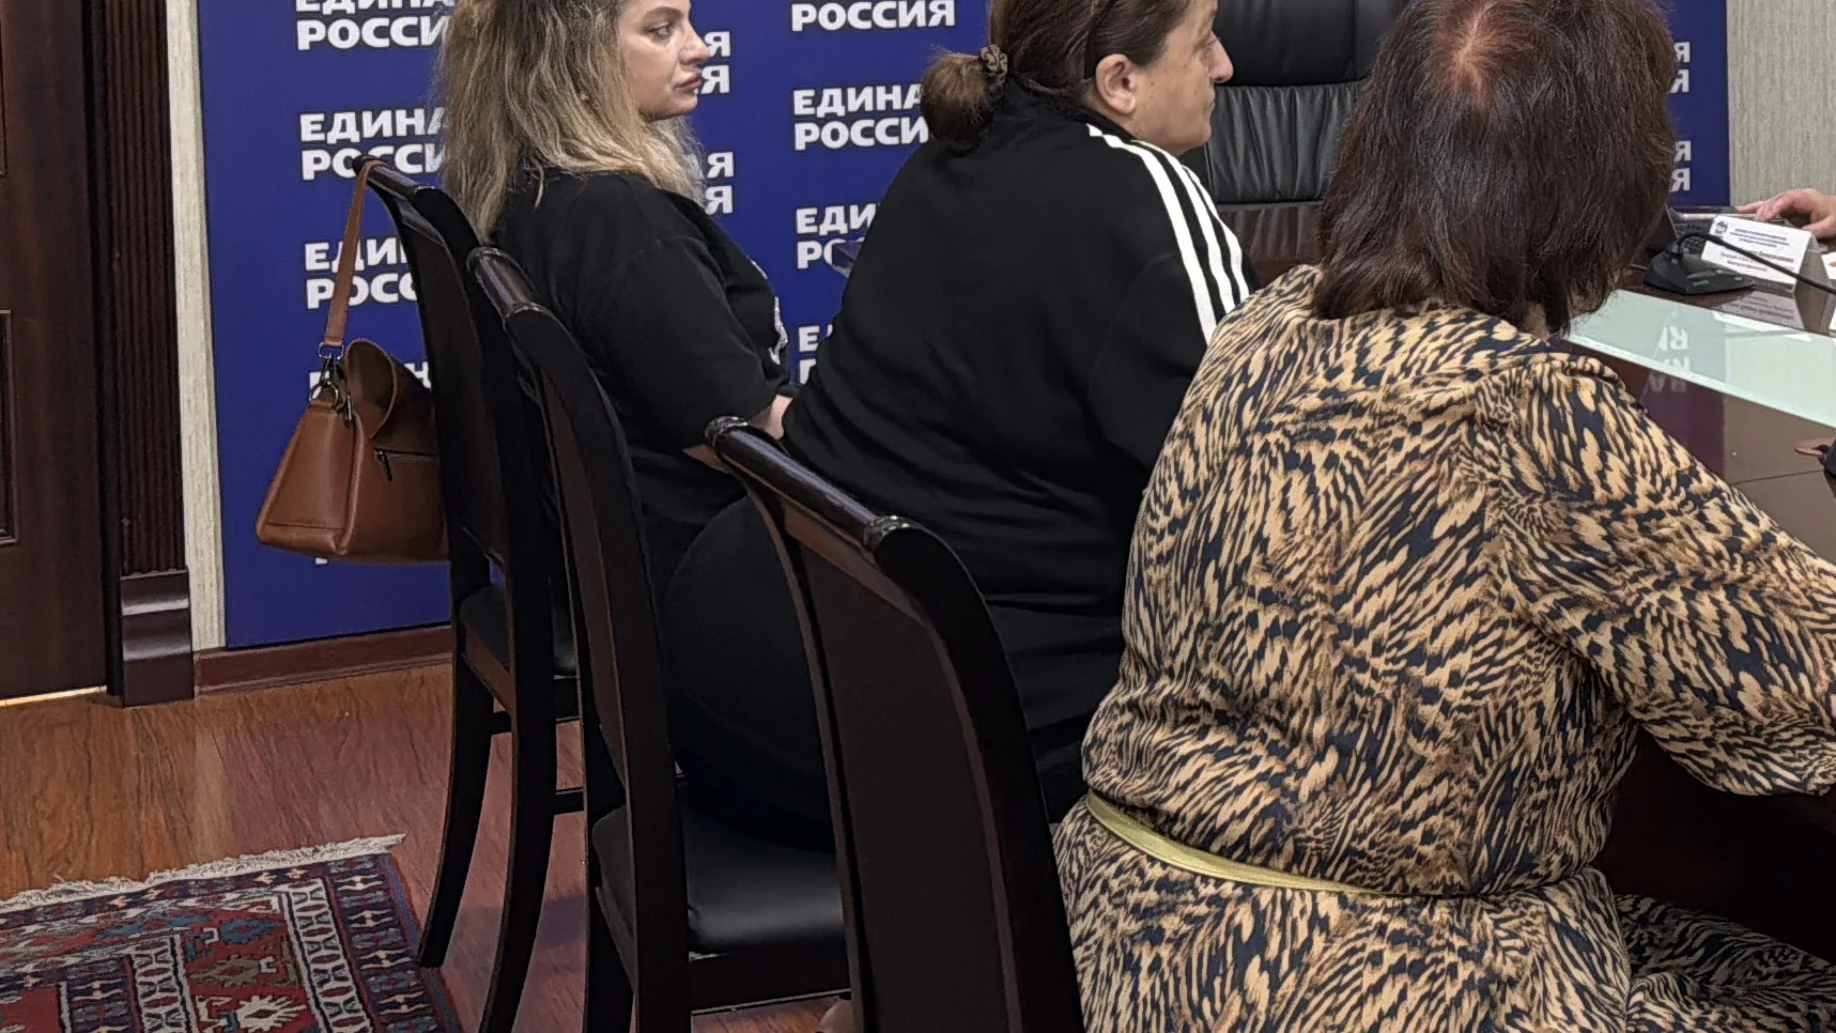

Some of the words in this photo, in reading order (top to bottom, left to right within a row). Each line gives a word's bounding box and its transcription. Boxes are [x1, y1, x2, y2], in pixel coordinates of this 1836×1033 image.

[296, 15, 450, 51] РОССИ
[791, 0, 955, 32] РОССИЯ
[793, 83, 922, 118] ЕДИНА
[794, 115, 930, 151] РОССИ
[796, 203, 878, 236] ЕДИ
